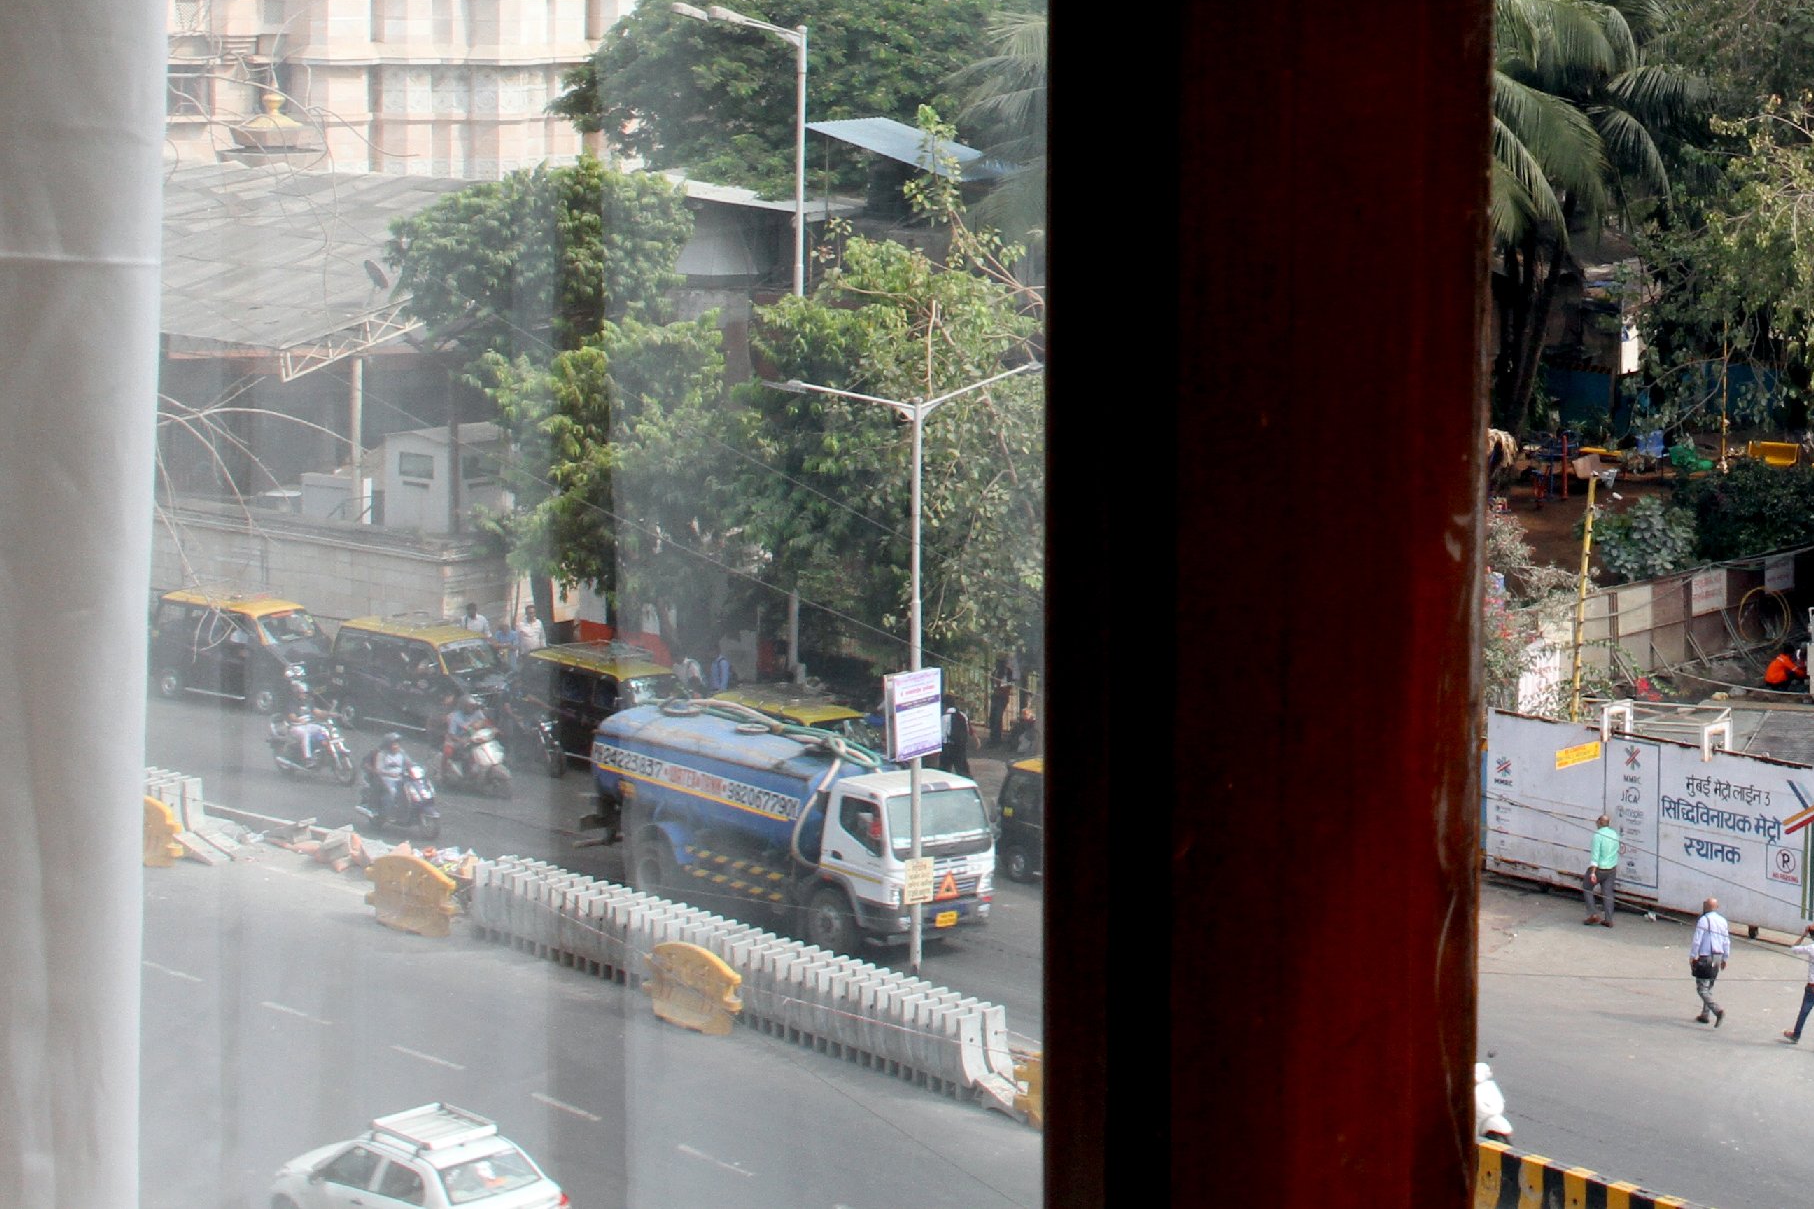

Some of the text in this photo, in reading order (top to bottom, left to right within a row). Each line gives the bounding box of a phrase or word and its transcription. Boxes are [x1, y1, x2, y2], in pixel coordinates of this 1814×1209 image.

[1686, 774, 1711, 797] मुंबई
[1764, 791, 1771, 806] 3
[1683, 836, 1741, 865] स्थानक
